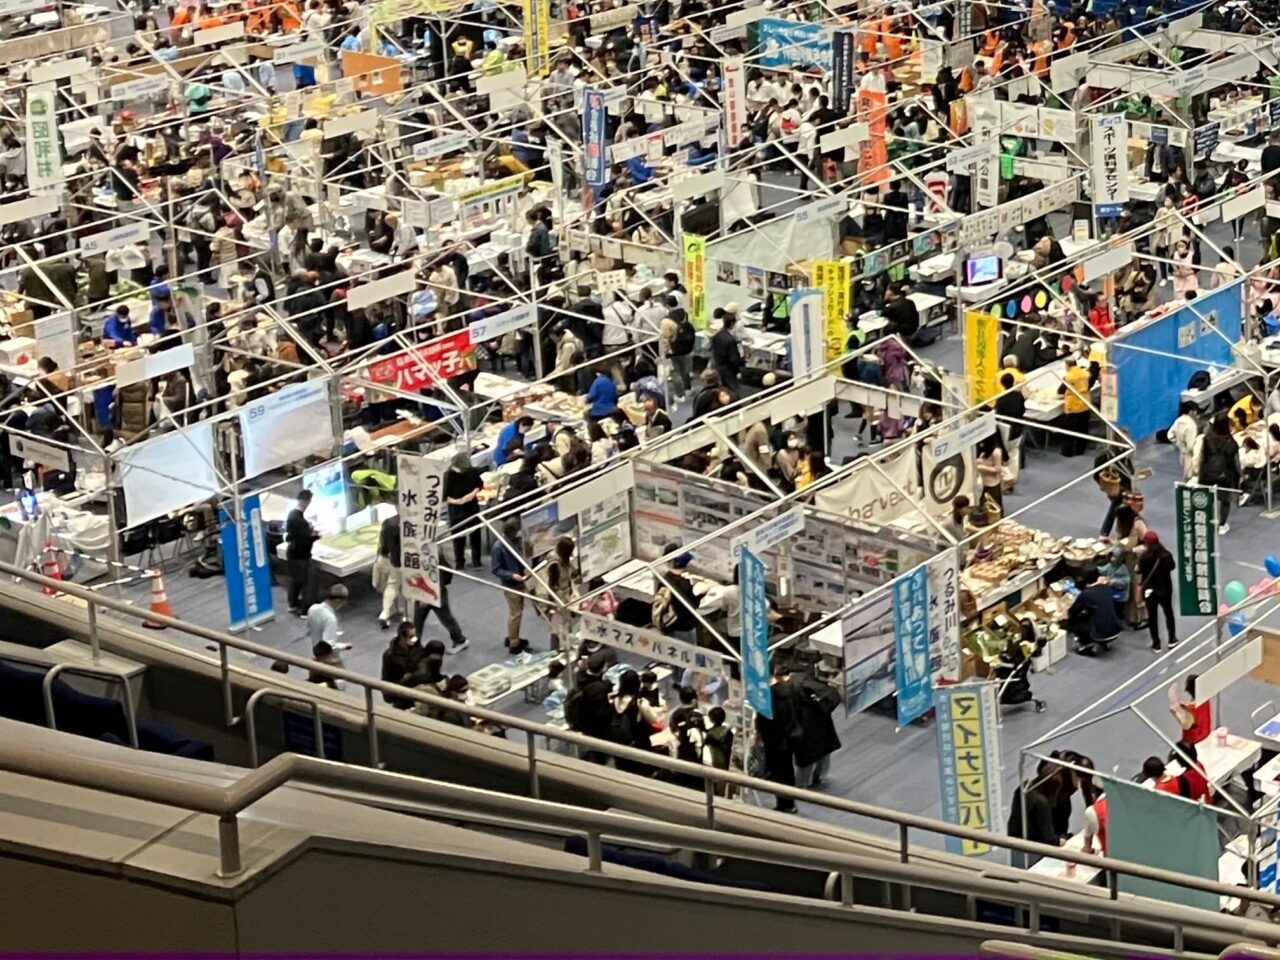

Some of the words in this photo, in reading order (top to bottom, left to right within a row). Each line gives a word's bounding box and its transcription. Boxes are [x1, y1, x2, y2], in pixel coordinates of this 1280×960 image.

[1103, 126, 1119, 201] スポーツ医科学センター
[472, 326, 487, 339] 57
[249, 405, 265, 419] 59
[934, 442, 949, 457] 67
